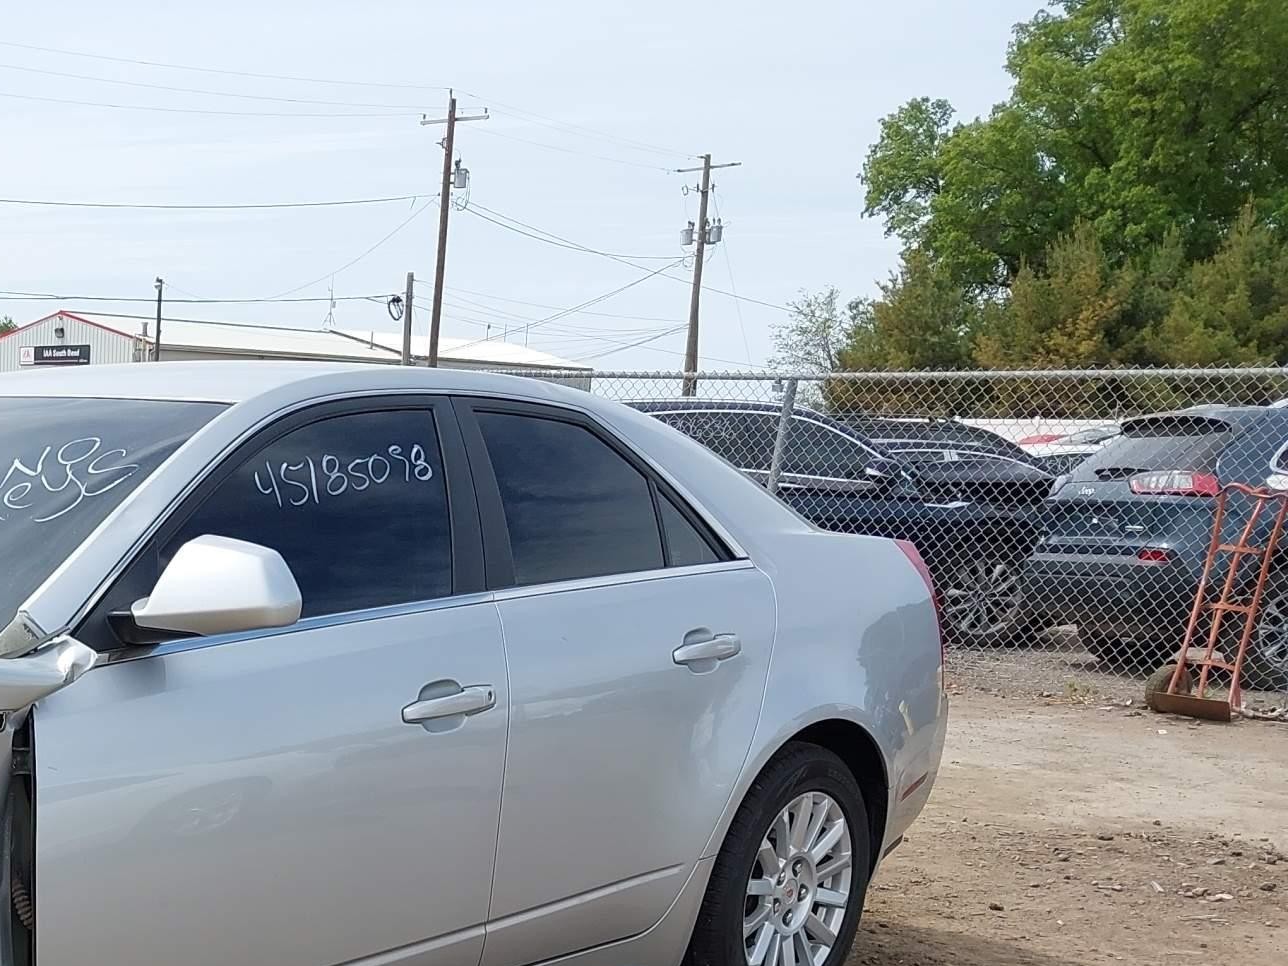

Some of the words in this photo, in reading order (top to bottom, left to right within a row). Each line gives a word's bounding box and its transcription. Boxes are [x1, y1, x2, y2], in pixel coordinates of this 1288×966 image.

[53, 348, 67, 357] South
[67, 348, 80, 357] Bend
[254, 444, 433, 508] 45185098
